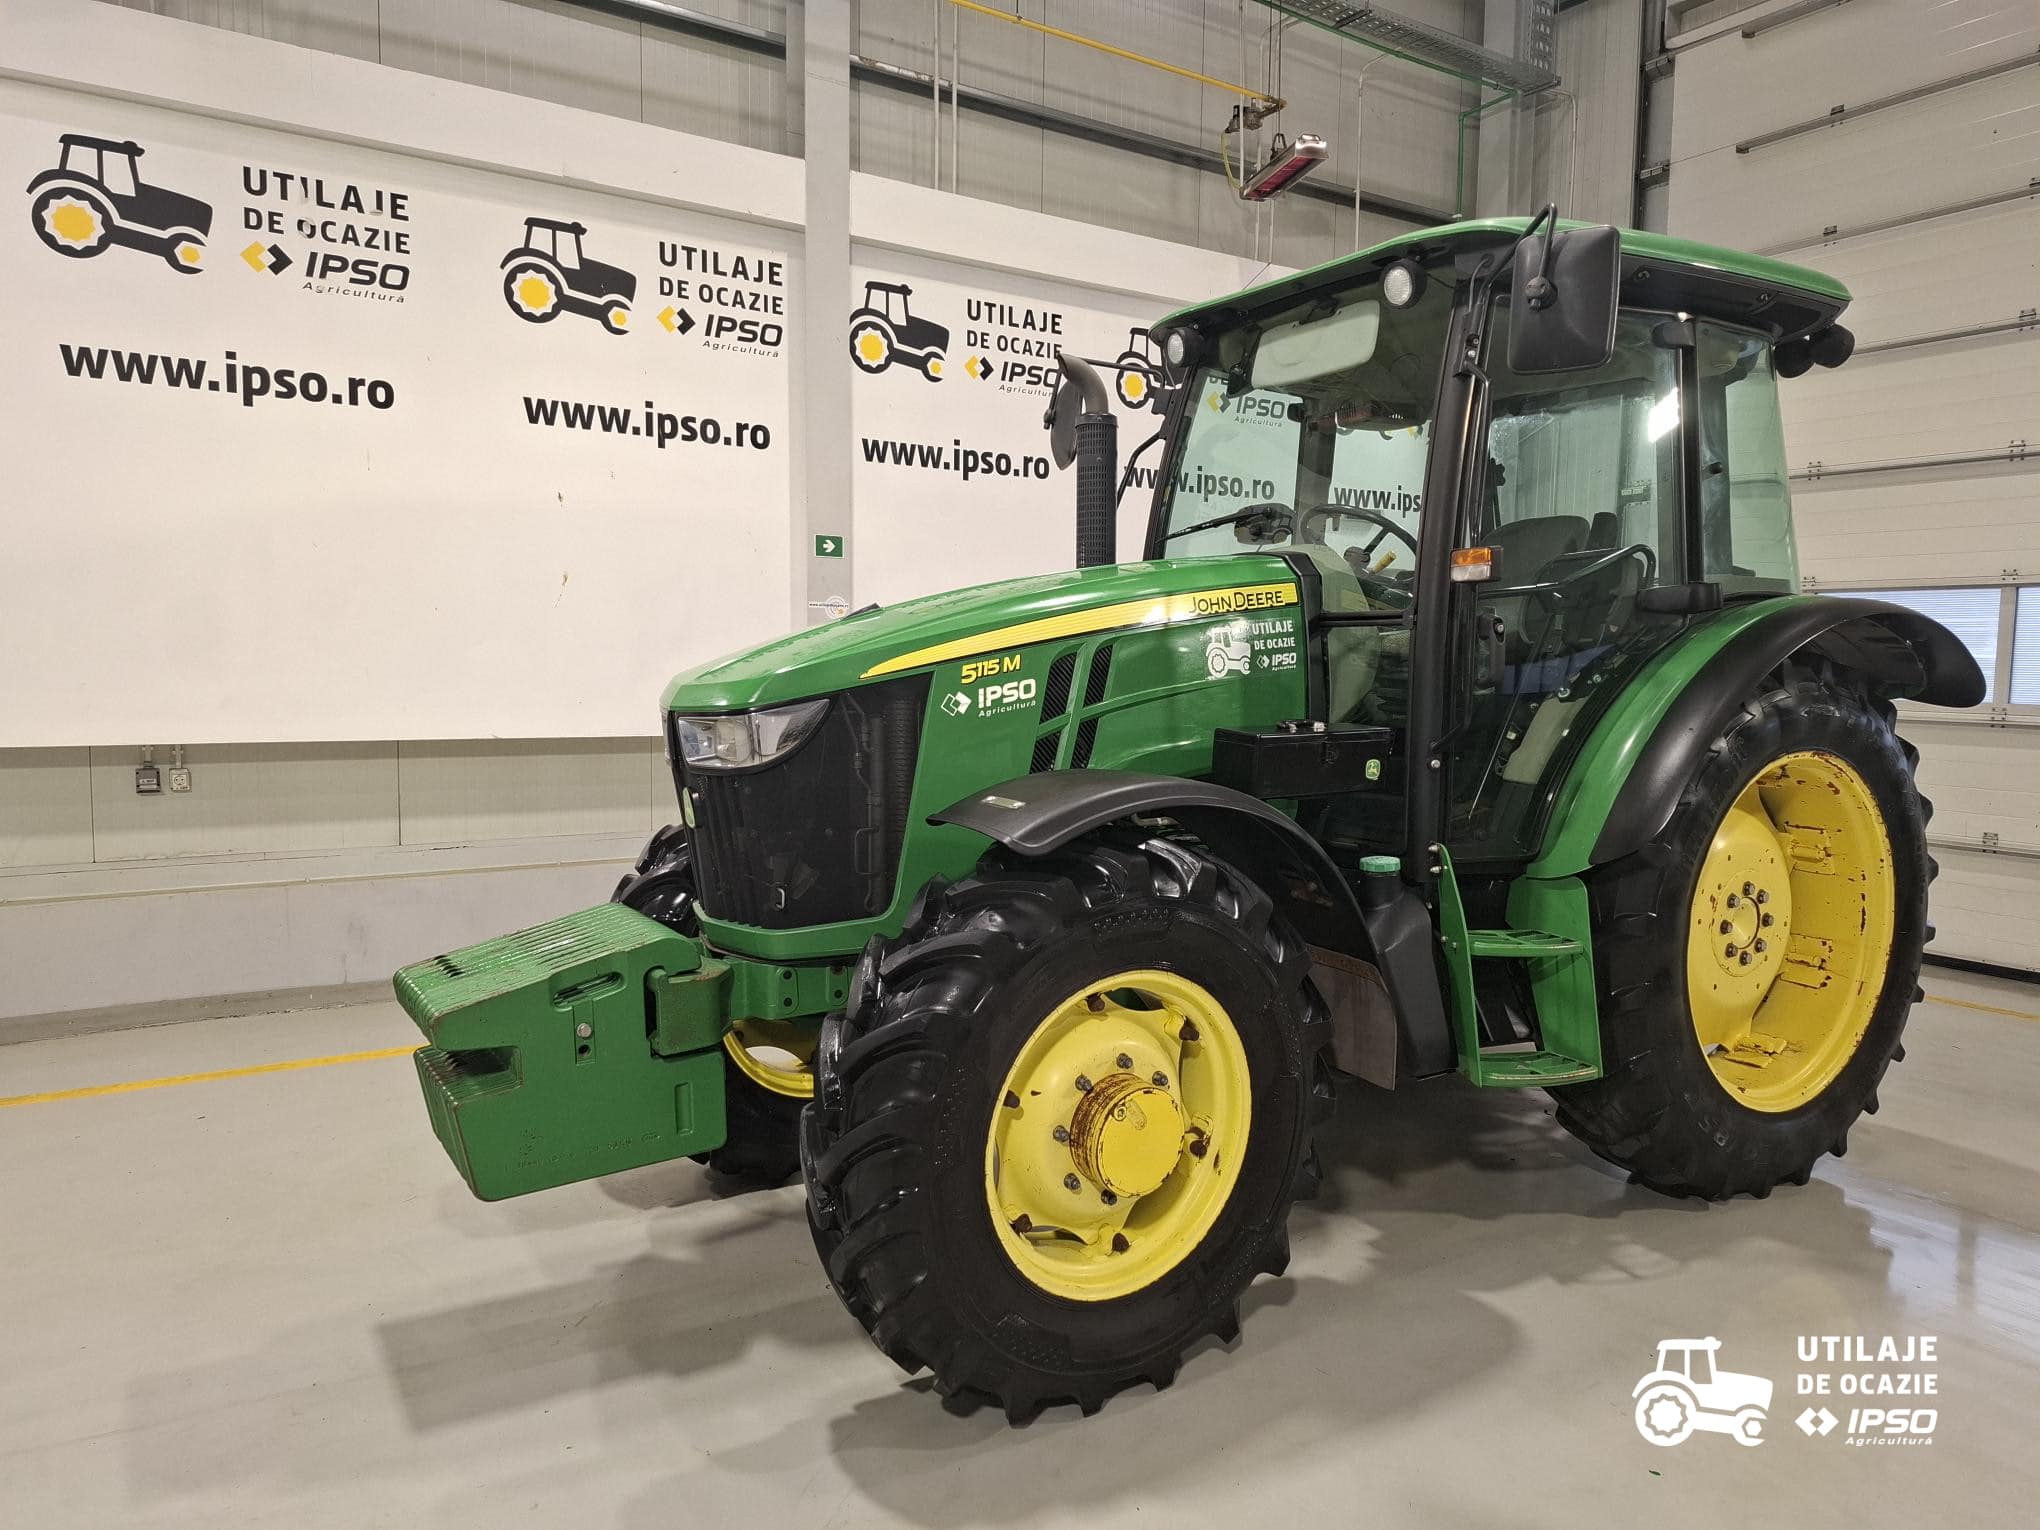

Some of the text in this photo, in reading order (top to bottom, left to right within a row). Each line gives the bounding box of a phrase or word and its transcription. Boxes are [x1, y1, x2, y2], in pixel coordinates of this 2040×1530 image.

[243, 206, 410, 254] DE OCAZIE
[306, 251, 410, 290] IPSO
[659, 241, 783, 286] UTILAJE
[659, 276, 783, 315] DE OCAZIE
[705, 313, 783, 347] IPSO
[967, 299, 1062, 335] UTILAJE
[966, 330, 1062, 360] DE OCAZIE
[59, 343, 394, 409] www.ipso.ro
[1001, 361, 1060, 388] IPSO
[523, 396, 771, 450] www.ipso.ro
[1237, 395, 1285, 419] IPSO
[862, 438, 1050, 480] www.ipso.ro
[1189, 591, 1284, 614] JOHN DEERE
[1252, 620, 1294, 635] UTILAJE
[1254, 637, 1296, 650] DE OCAZIE
[1272, 652, 1297, 667] IPSO
[978, 678, 1037, 708] IPSO
